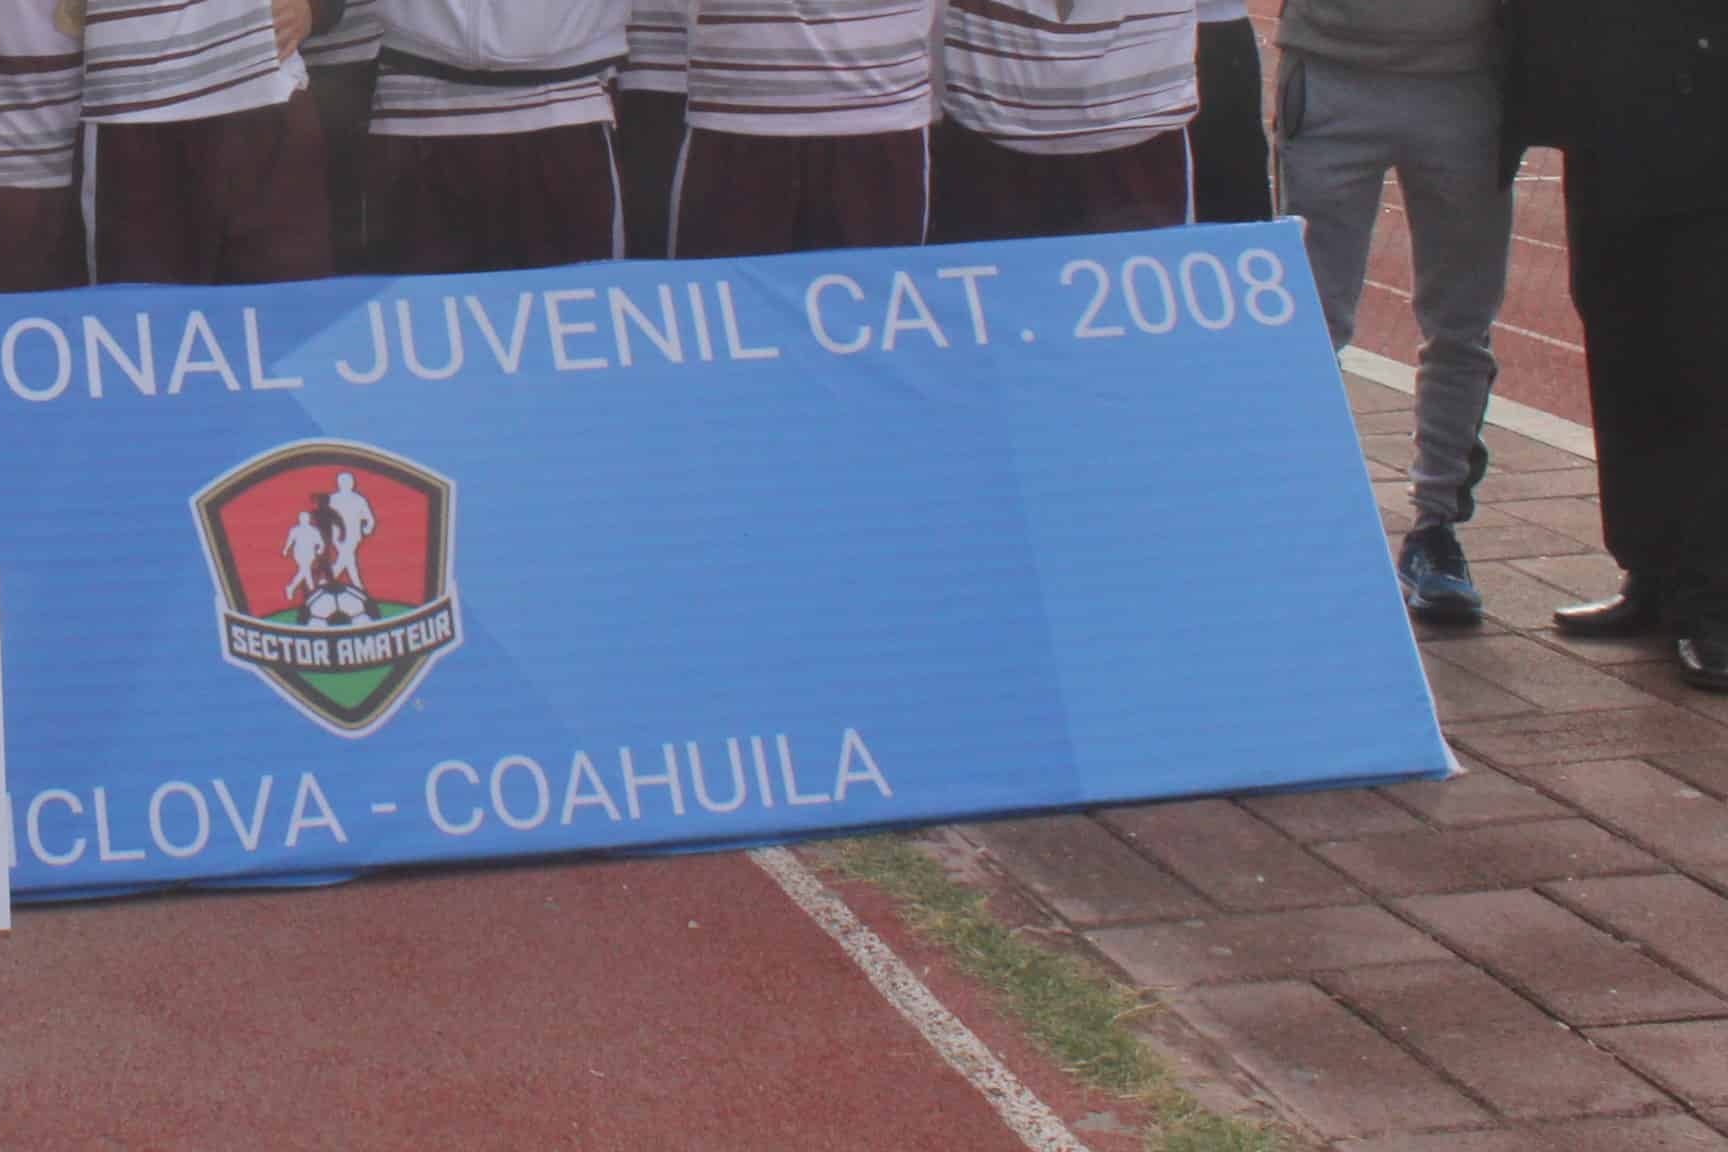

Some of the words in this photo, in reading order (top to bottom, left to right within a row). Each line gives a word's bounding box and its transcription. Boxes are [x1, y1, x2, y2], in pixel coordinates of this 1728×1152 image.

[335, 280, 778, 385] JUVENIL
[1060, 248, 1296, 340] 2008
[230, 623, 332, 667] SECTOR
[335, 608, 453, 667] AMATEUR
[7, 772, 349, 870] CLOVA
[424, 726, 894, 837] COAHUILA
